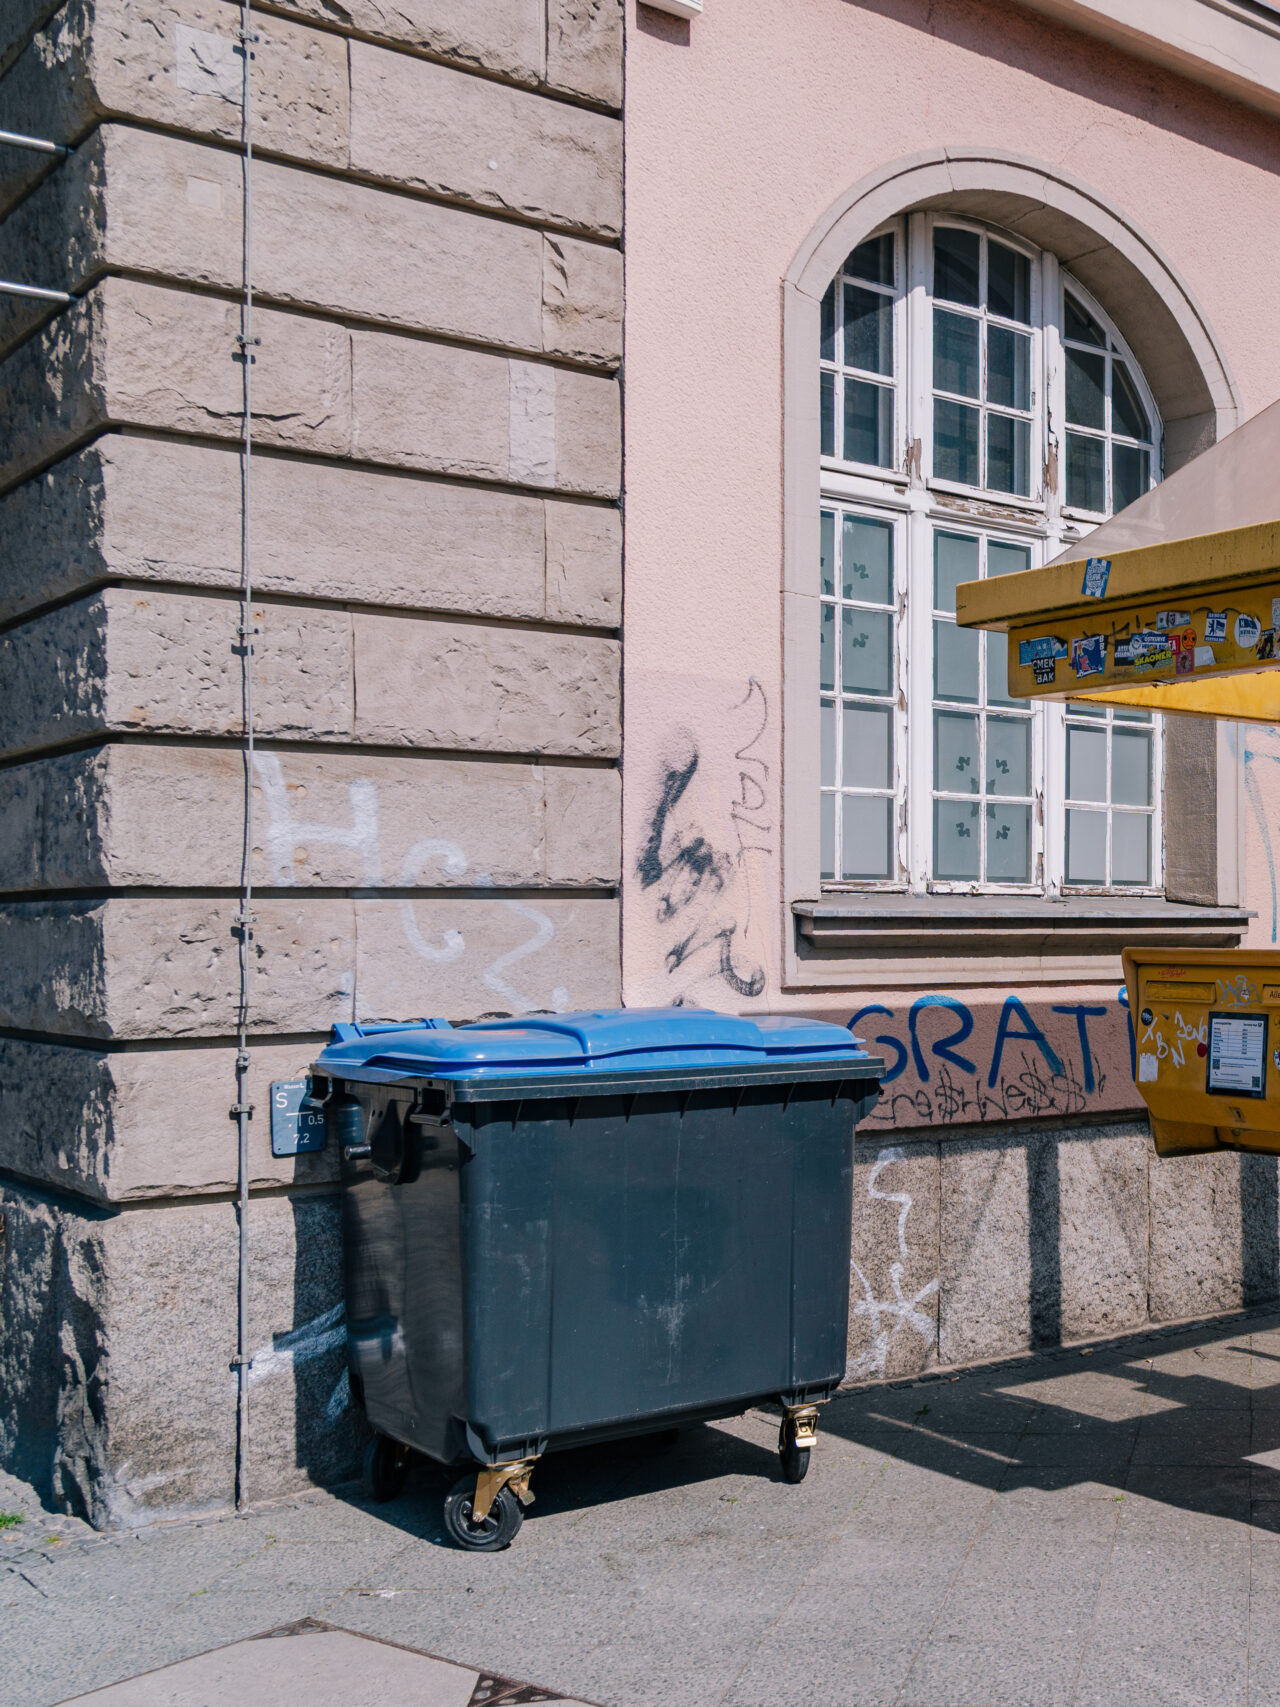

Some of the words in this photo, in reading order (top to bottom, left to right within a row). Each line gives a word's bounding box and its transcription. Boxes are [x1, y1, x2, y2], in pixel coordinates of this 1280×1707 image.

[275, 1092, 288, 1109] S
[308, 1114, 325, 1126] 0.5
[293, 1133, 310, 1145] 7.2
